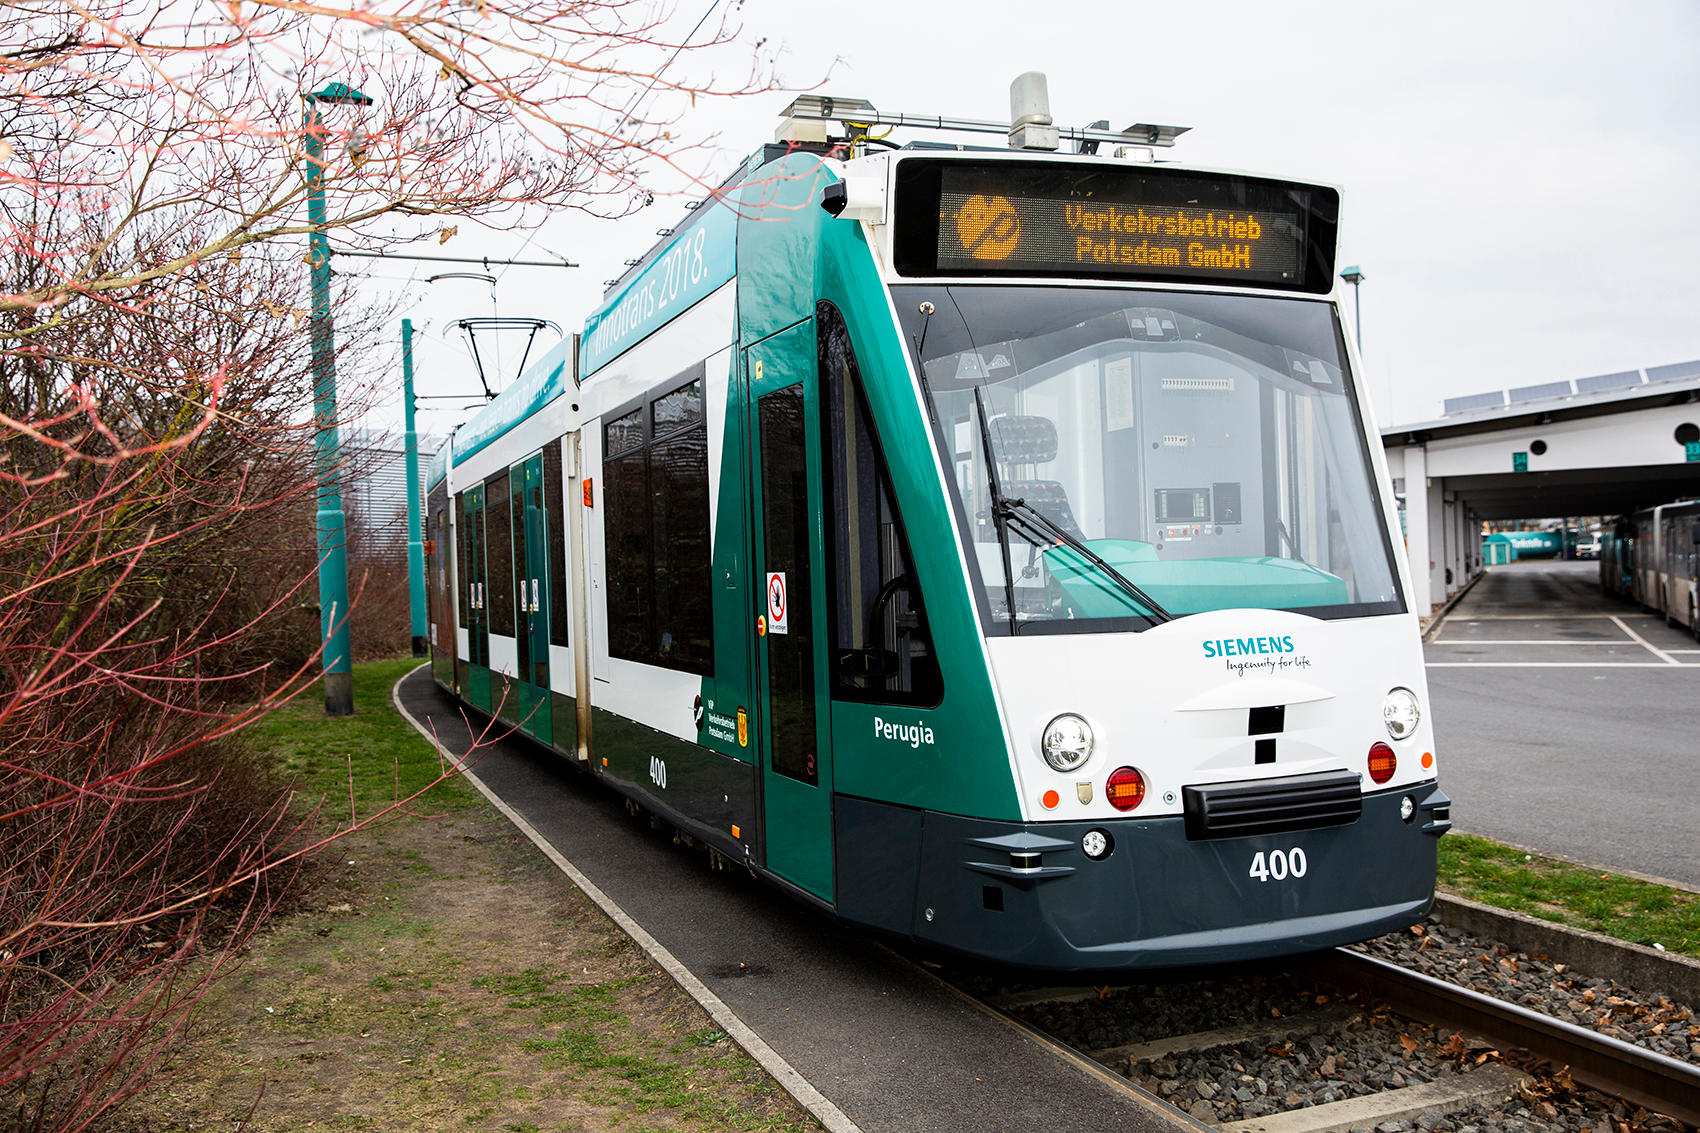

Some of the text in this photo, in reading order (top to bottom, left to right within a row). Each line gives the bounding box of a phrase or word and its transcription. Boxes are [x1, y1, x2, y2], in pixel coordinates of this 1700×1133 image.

[1065, 204, 1261, 240] Verkehrsbetrieb
[658, 227, 708, 310] 2018.
[1076, 236, 1250, 269] Potsdam GmbH
[1202, 635, 1295, 658] SIEMENS
[1226, 655, 1312, 678] Ingenuity for life
[874, 716, 935, 749] Perugia
[649, 755, 667, 790] 400
[1248, 846, 1308, 882] 400
